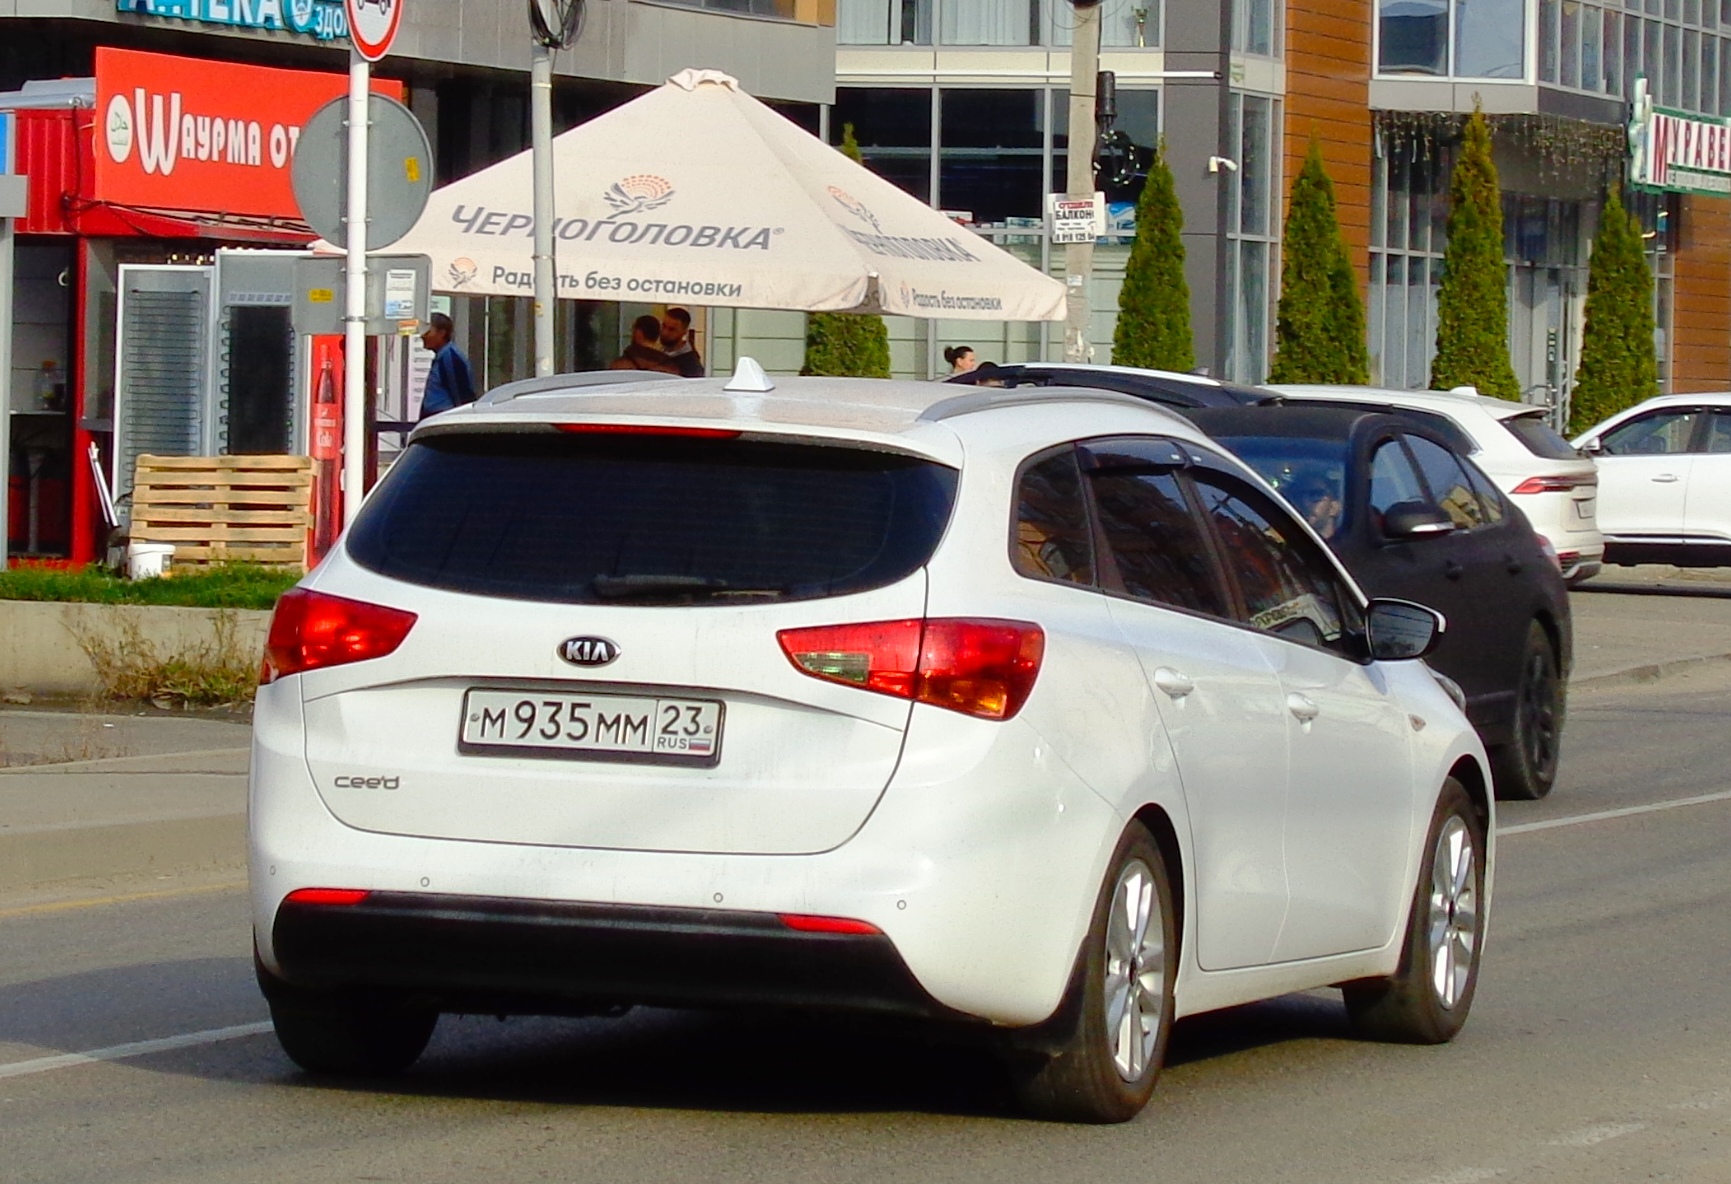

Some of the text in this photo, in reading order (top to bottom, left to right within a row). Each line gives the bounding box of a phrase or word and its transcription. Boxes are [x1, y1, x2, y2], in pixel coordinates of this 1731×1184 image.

[1653, 114, 1731, 184] МУРАВЕ
[451, 204, 770, 250] ЧЕРОГОЛОВКА
[492, 265, 742, 297] Радть без остановки
[566, 641, 609, 661] KIA
[660, 705, 702, 736] 23
[656, 736, 688, 750] RUS
[334, 775, 400, 790] cee'd
